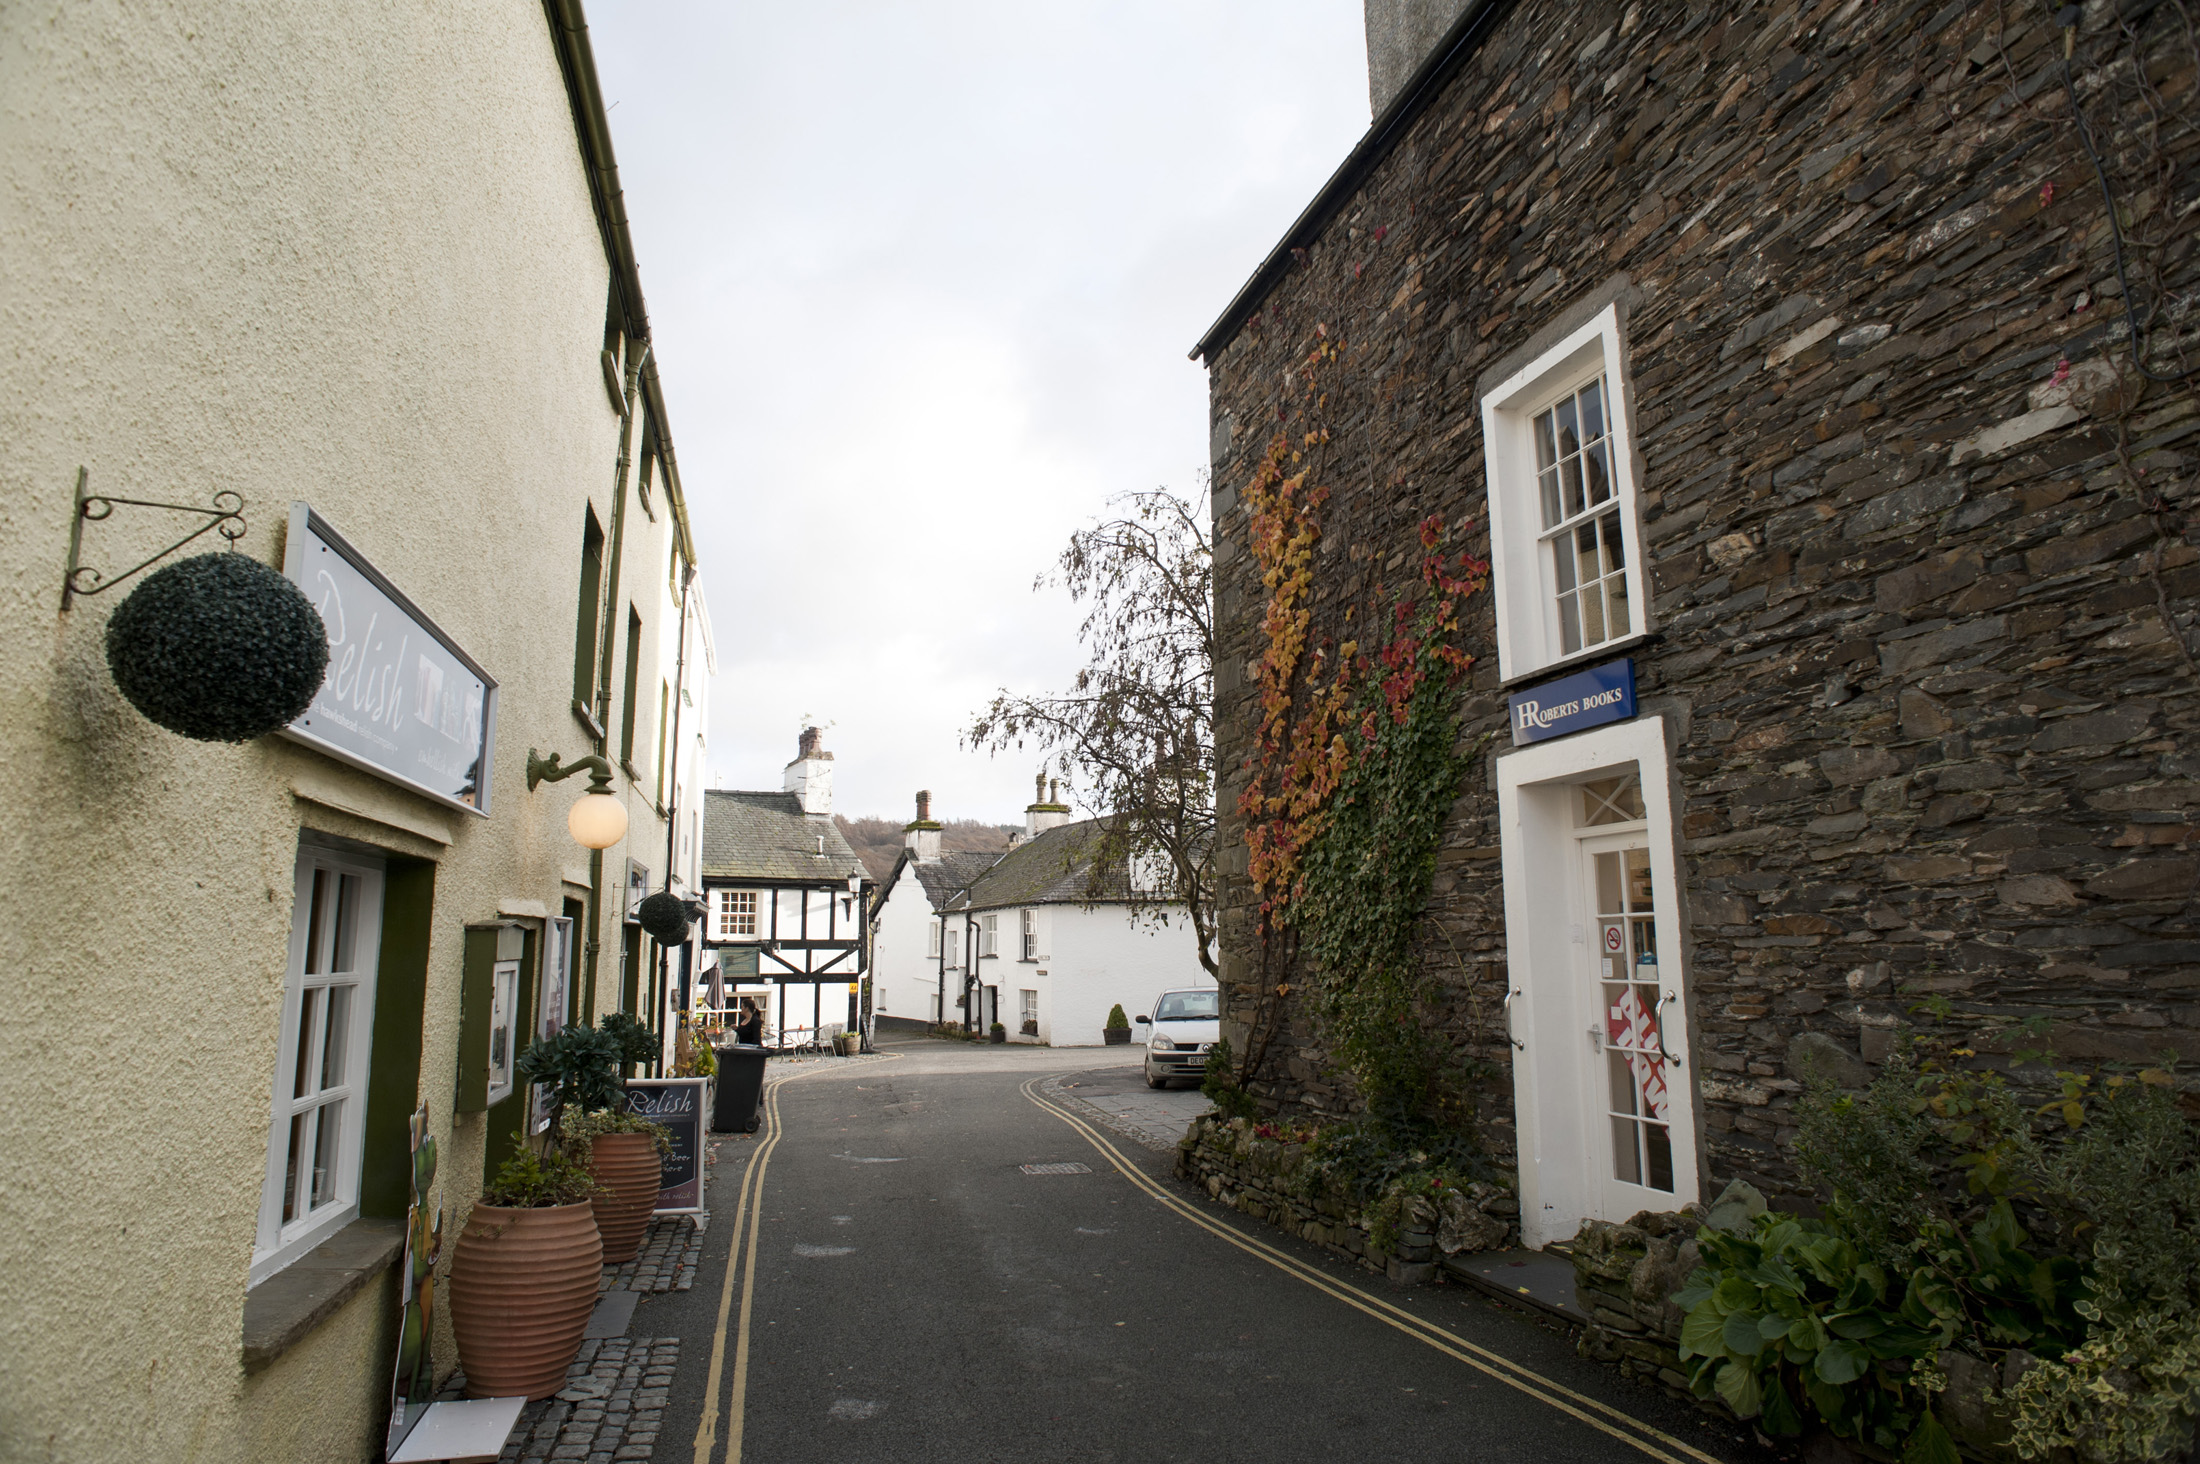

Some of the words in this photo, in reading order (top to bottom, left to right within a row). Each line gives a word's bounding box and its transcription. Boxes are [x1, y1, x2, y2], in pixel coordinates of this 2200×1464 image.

[1583, 687, 1622, 711] BOOKS
[627, 1088, 693, 1113] Relish
[672, 1151, 690, 1161] Beer
